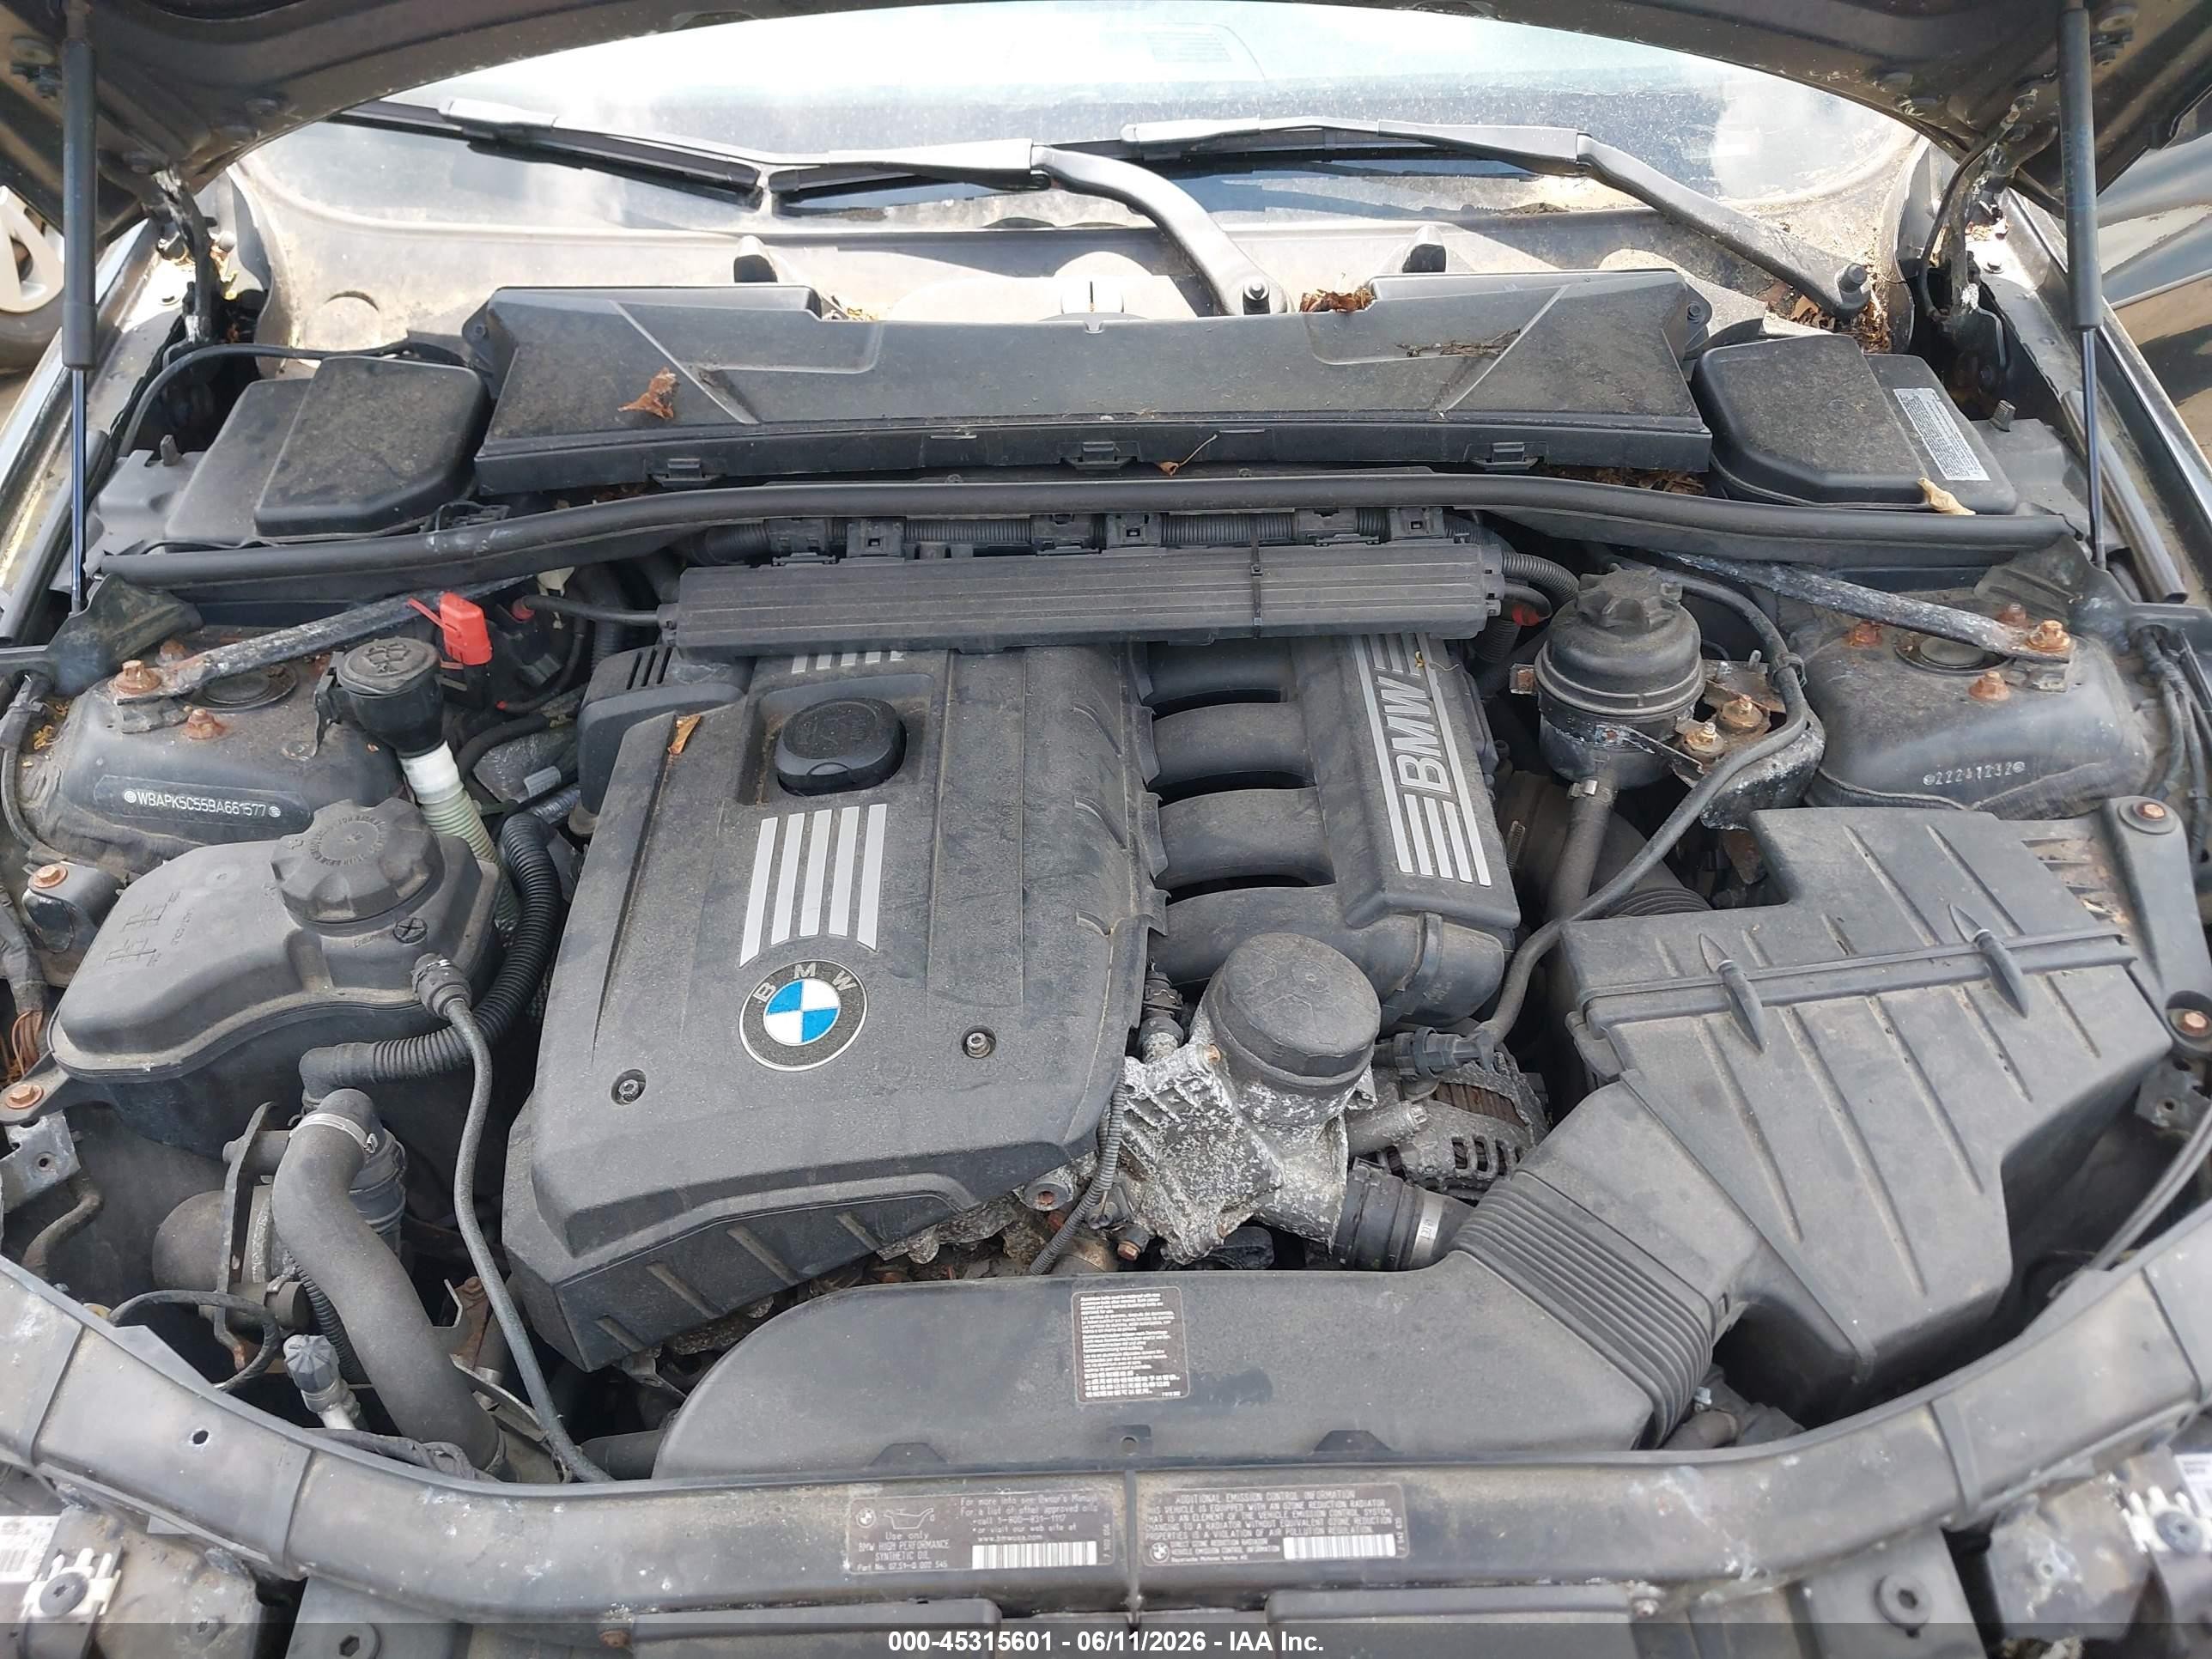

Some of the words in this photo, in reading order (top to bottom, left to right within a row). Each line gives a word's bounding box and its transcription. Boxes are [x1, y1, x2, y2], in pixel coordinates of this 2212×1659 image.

[1377, 677, 1451, 794] BMW
[137, 792, 266, 817] WBAPK5C55BA661577
[753, 963, 857, 1002] BMW
[961, 1497, 973, 1505] For
[1002, 1496, 1016, 1504] info
[1176, 1494, 1221, 1504] ADDITIONAL
[1226, 1492, 1262, 1502] EMISSION
[1267, 1492, 1297, 1501] CONTROL
[960, 1507, 974, 1516] For
[988, 1505, 1001, 1515] list
[1044, 1504, 1079, 1514] approved
[886, 1532, 902, 1540] Use
[908, 1531, 929, 1540] only
[899, 1539, 950, 1550] PERFORMANCE
[875, 1551, 914, 1561] SYNTHETIC
[918, 1551, 930, 1559] OIL
